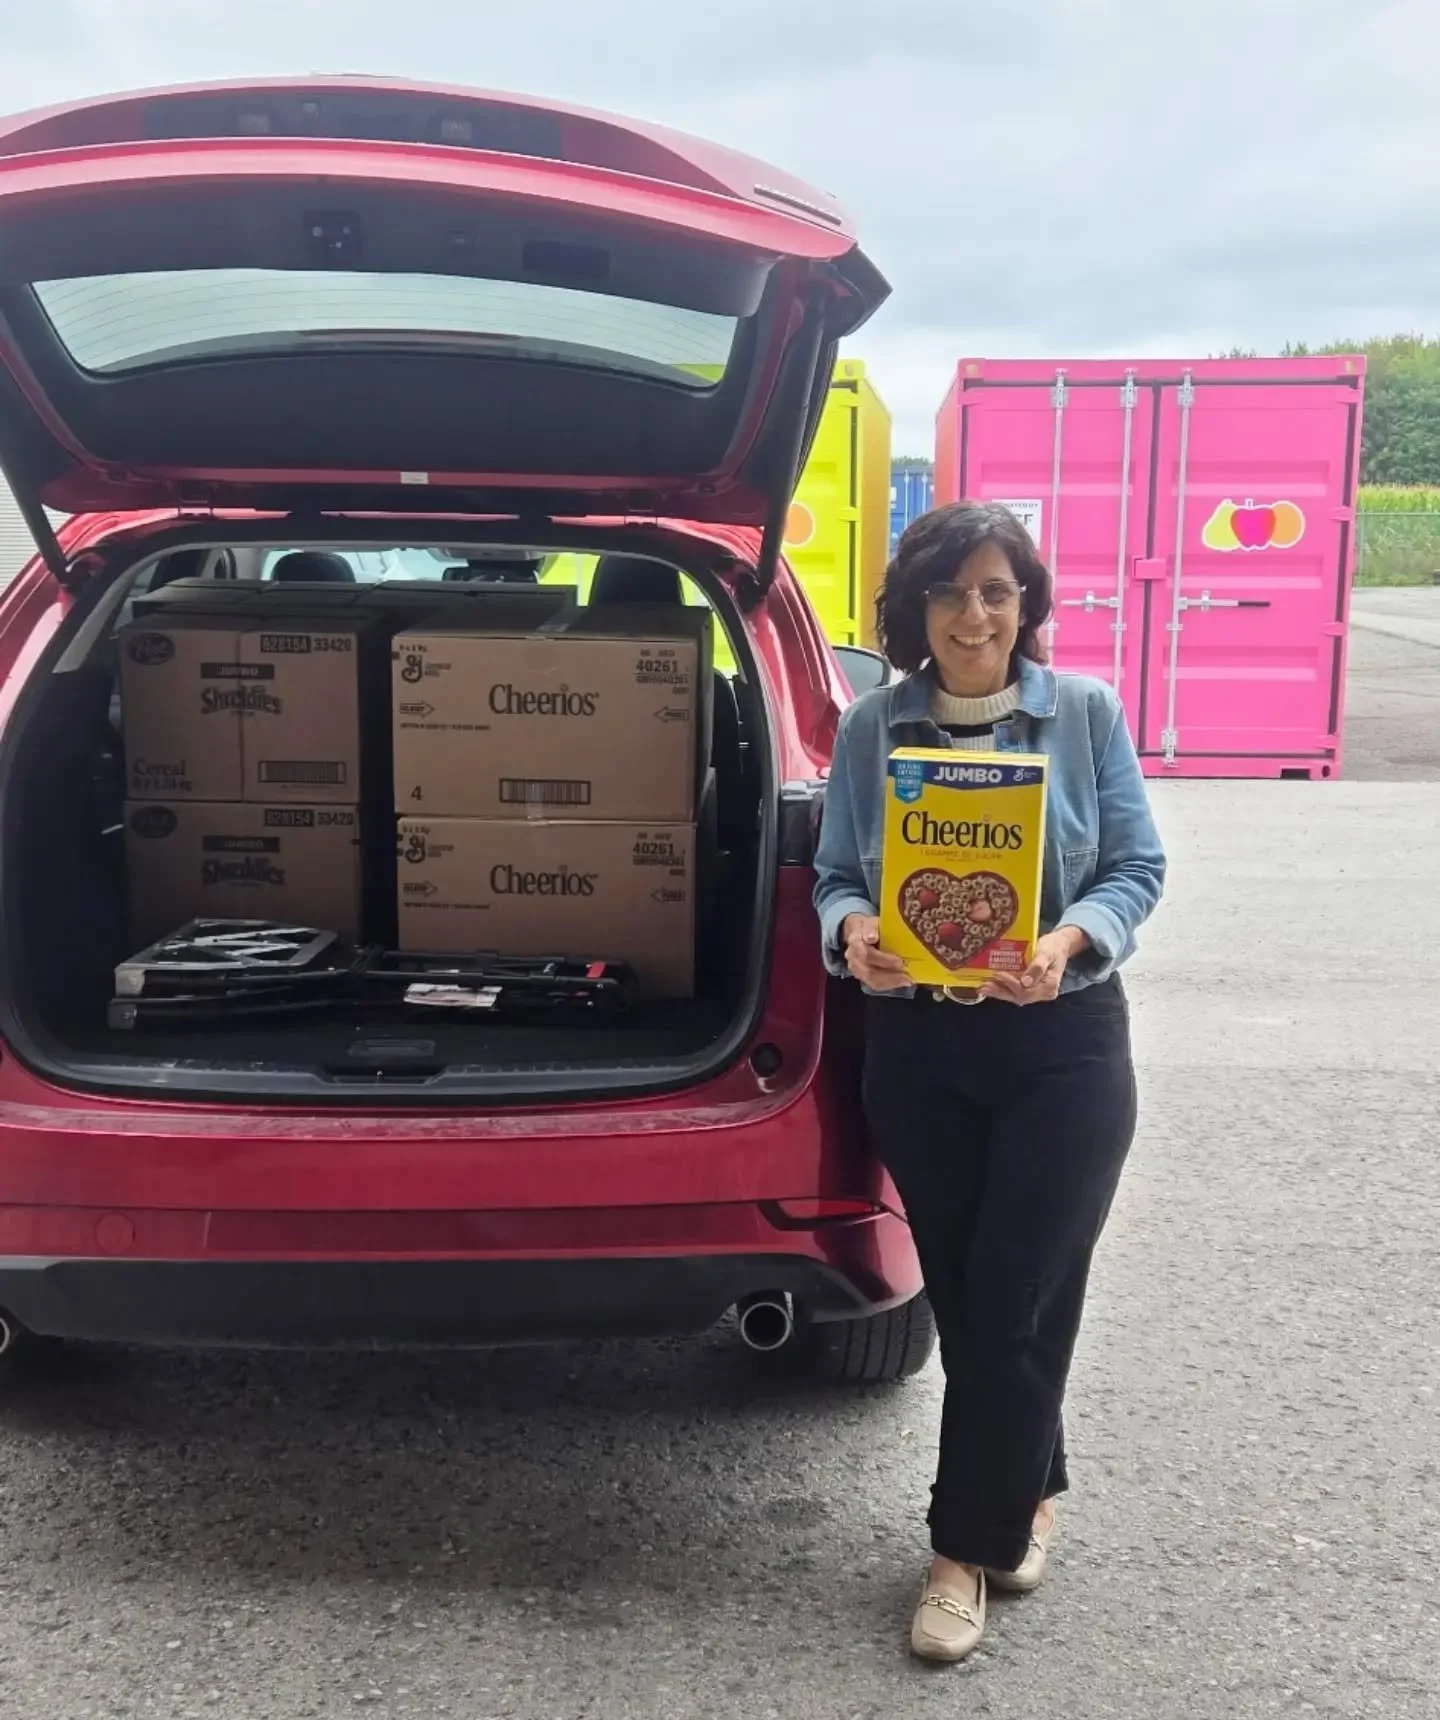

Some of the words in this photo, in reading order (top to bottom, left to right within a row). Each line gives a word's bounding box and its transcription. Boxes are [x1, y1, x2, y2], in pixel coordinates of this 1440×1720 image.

[635, 659, 679, 673] 40261
[489, 683, 599, 716] Cheerios
[933, 766, 1003, 783] JUMBO
[410, 785, 422, 801] 4
[902, 810, 1022, 850] Cheerios
[632, 841, 675, 855] 40261
[490, 864, 597, 896] Cheerios
